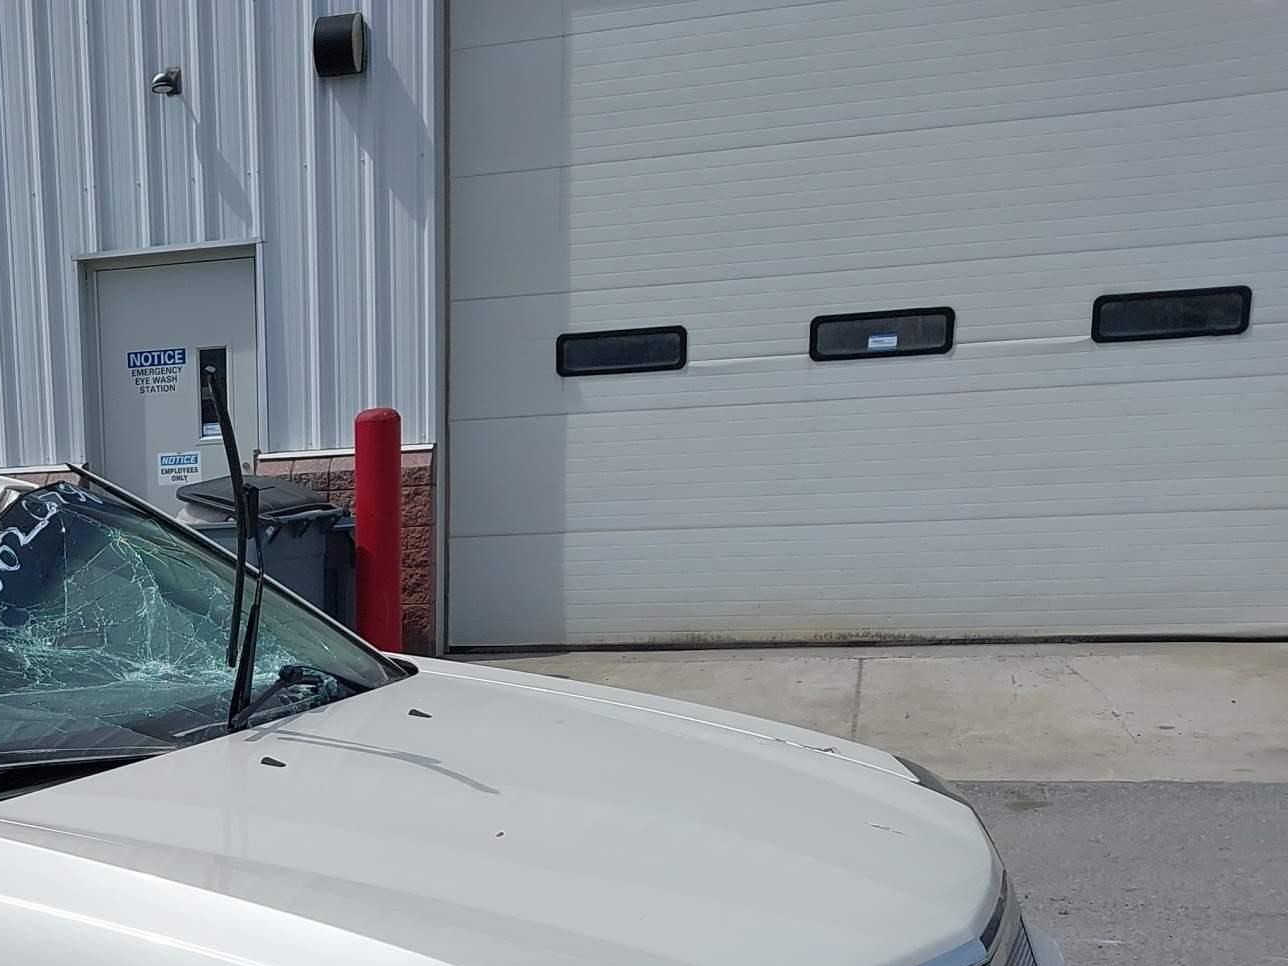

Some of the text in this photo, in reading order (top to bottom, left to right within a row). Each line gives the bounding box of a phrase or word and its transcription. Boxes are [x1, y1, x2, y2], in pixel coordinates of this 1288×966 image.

[129, 350, 184, 367] NOTICE
[131, 366, 183, 377] EMERGENCY
[135, 375, 178, 386] EYE WASH
[139, 384, 176, 394] STATION
[162, 455, 197, 465] NOTICE
[160, 466, 199, 475] EMPLOYEES
[171, 474, 189, 483] ONLY
